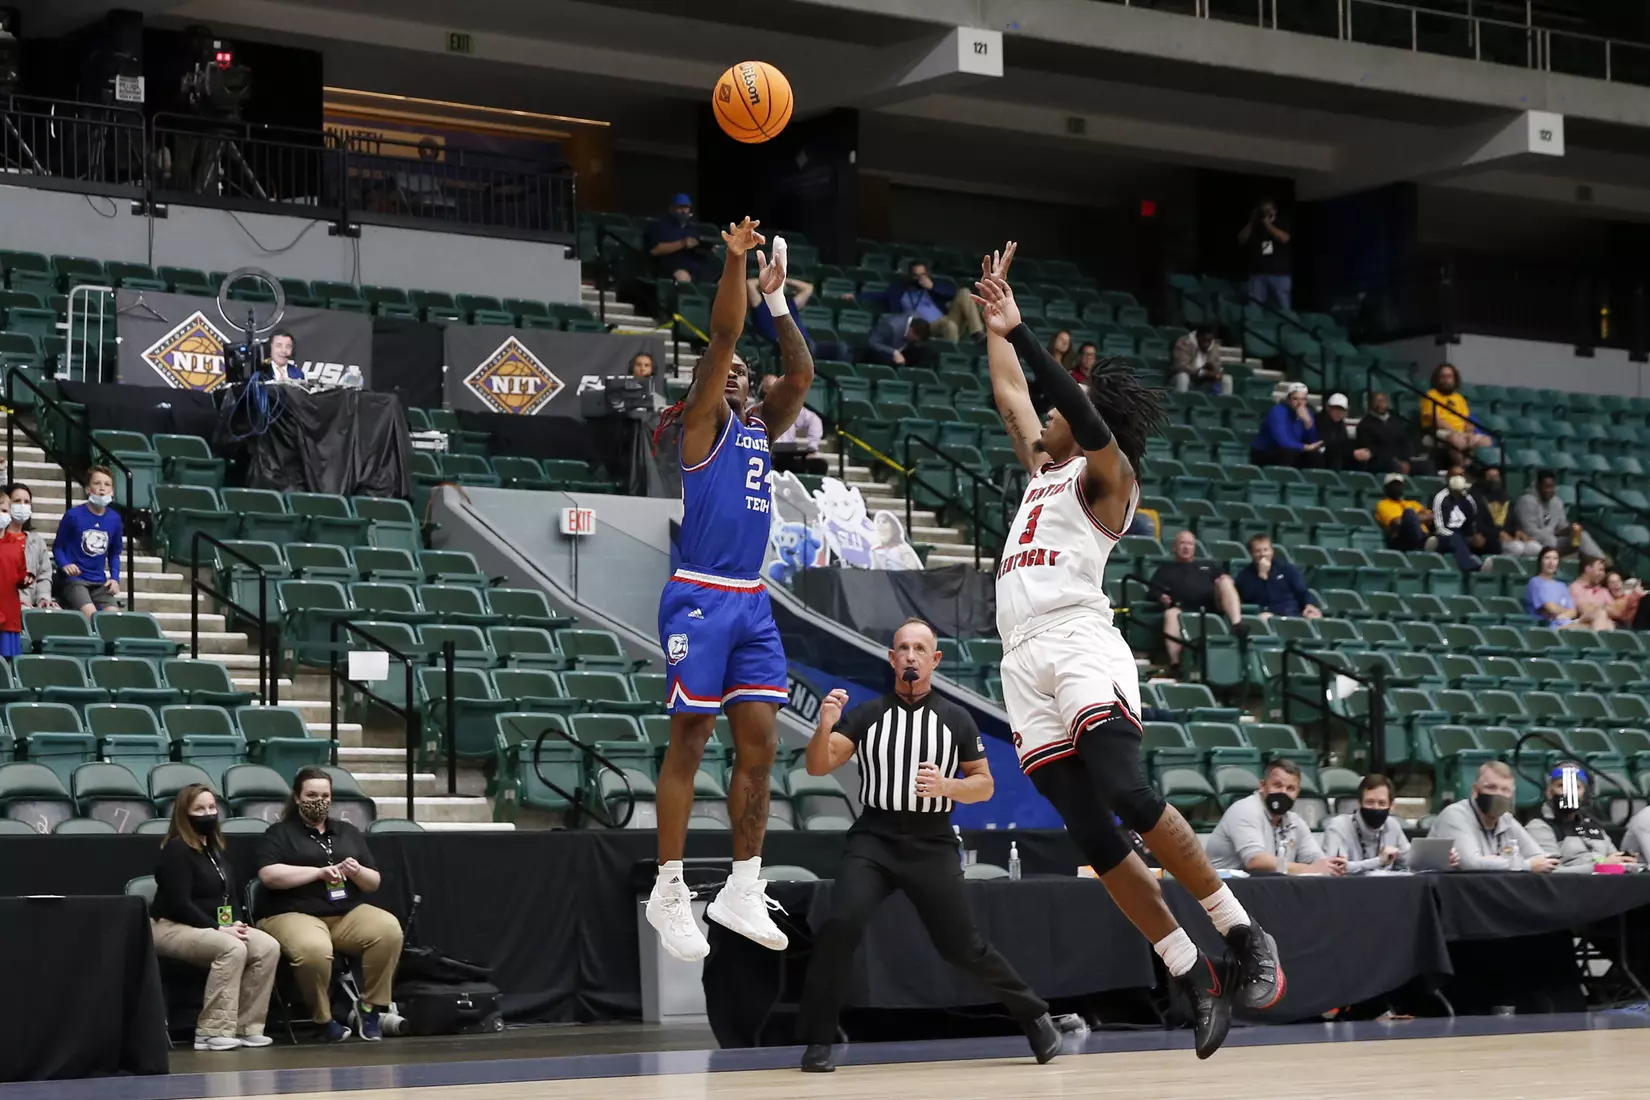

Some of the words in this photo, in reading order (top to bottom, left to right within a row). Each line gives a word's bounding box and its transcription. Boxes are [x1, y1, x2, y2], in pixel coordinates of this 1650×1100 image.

[973, 41, 988, 56] 121
[171, 350, 226, 375] NIT
[490, 375, 541, 395] NIT
[568, 510, 592, 532] EXIT
[1018, 504, 1044, 545] 3
[114, 807, 130, 834] 7
